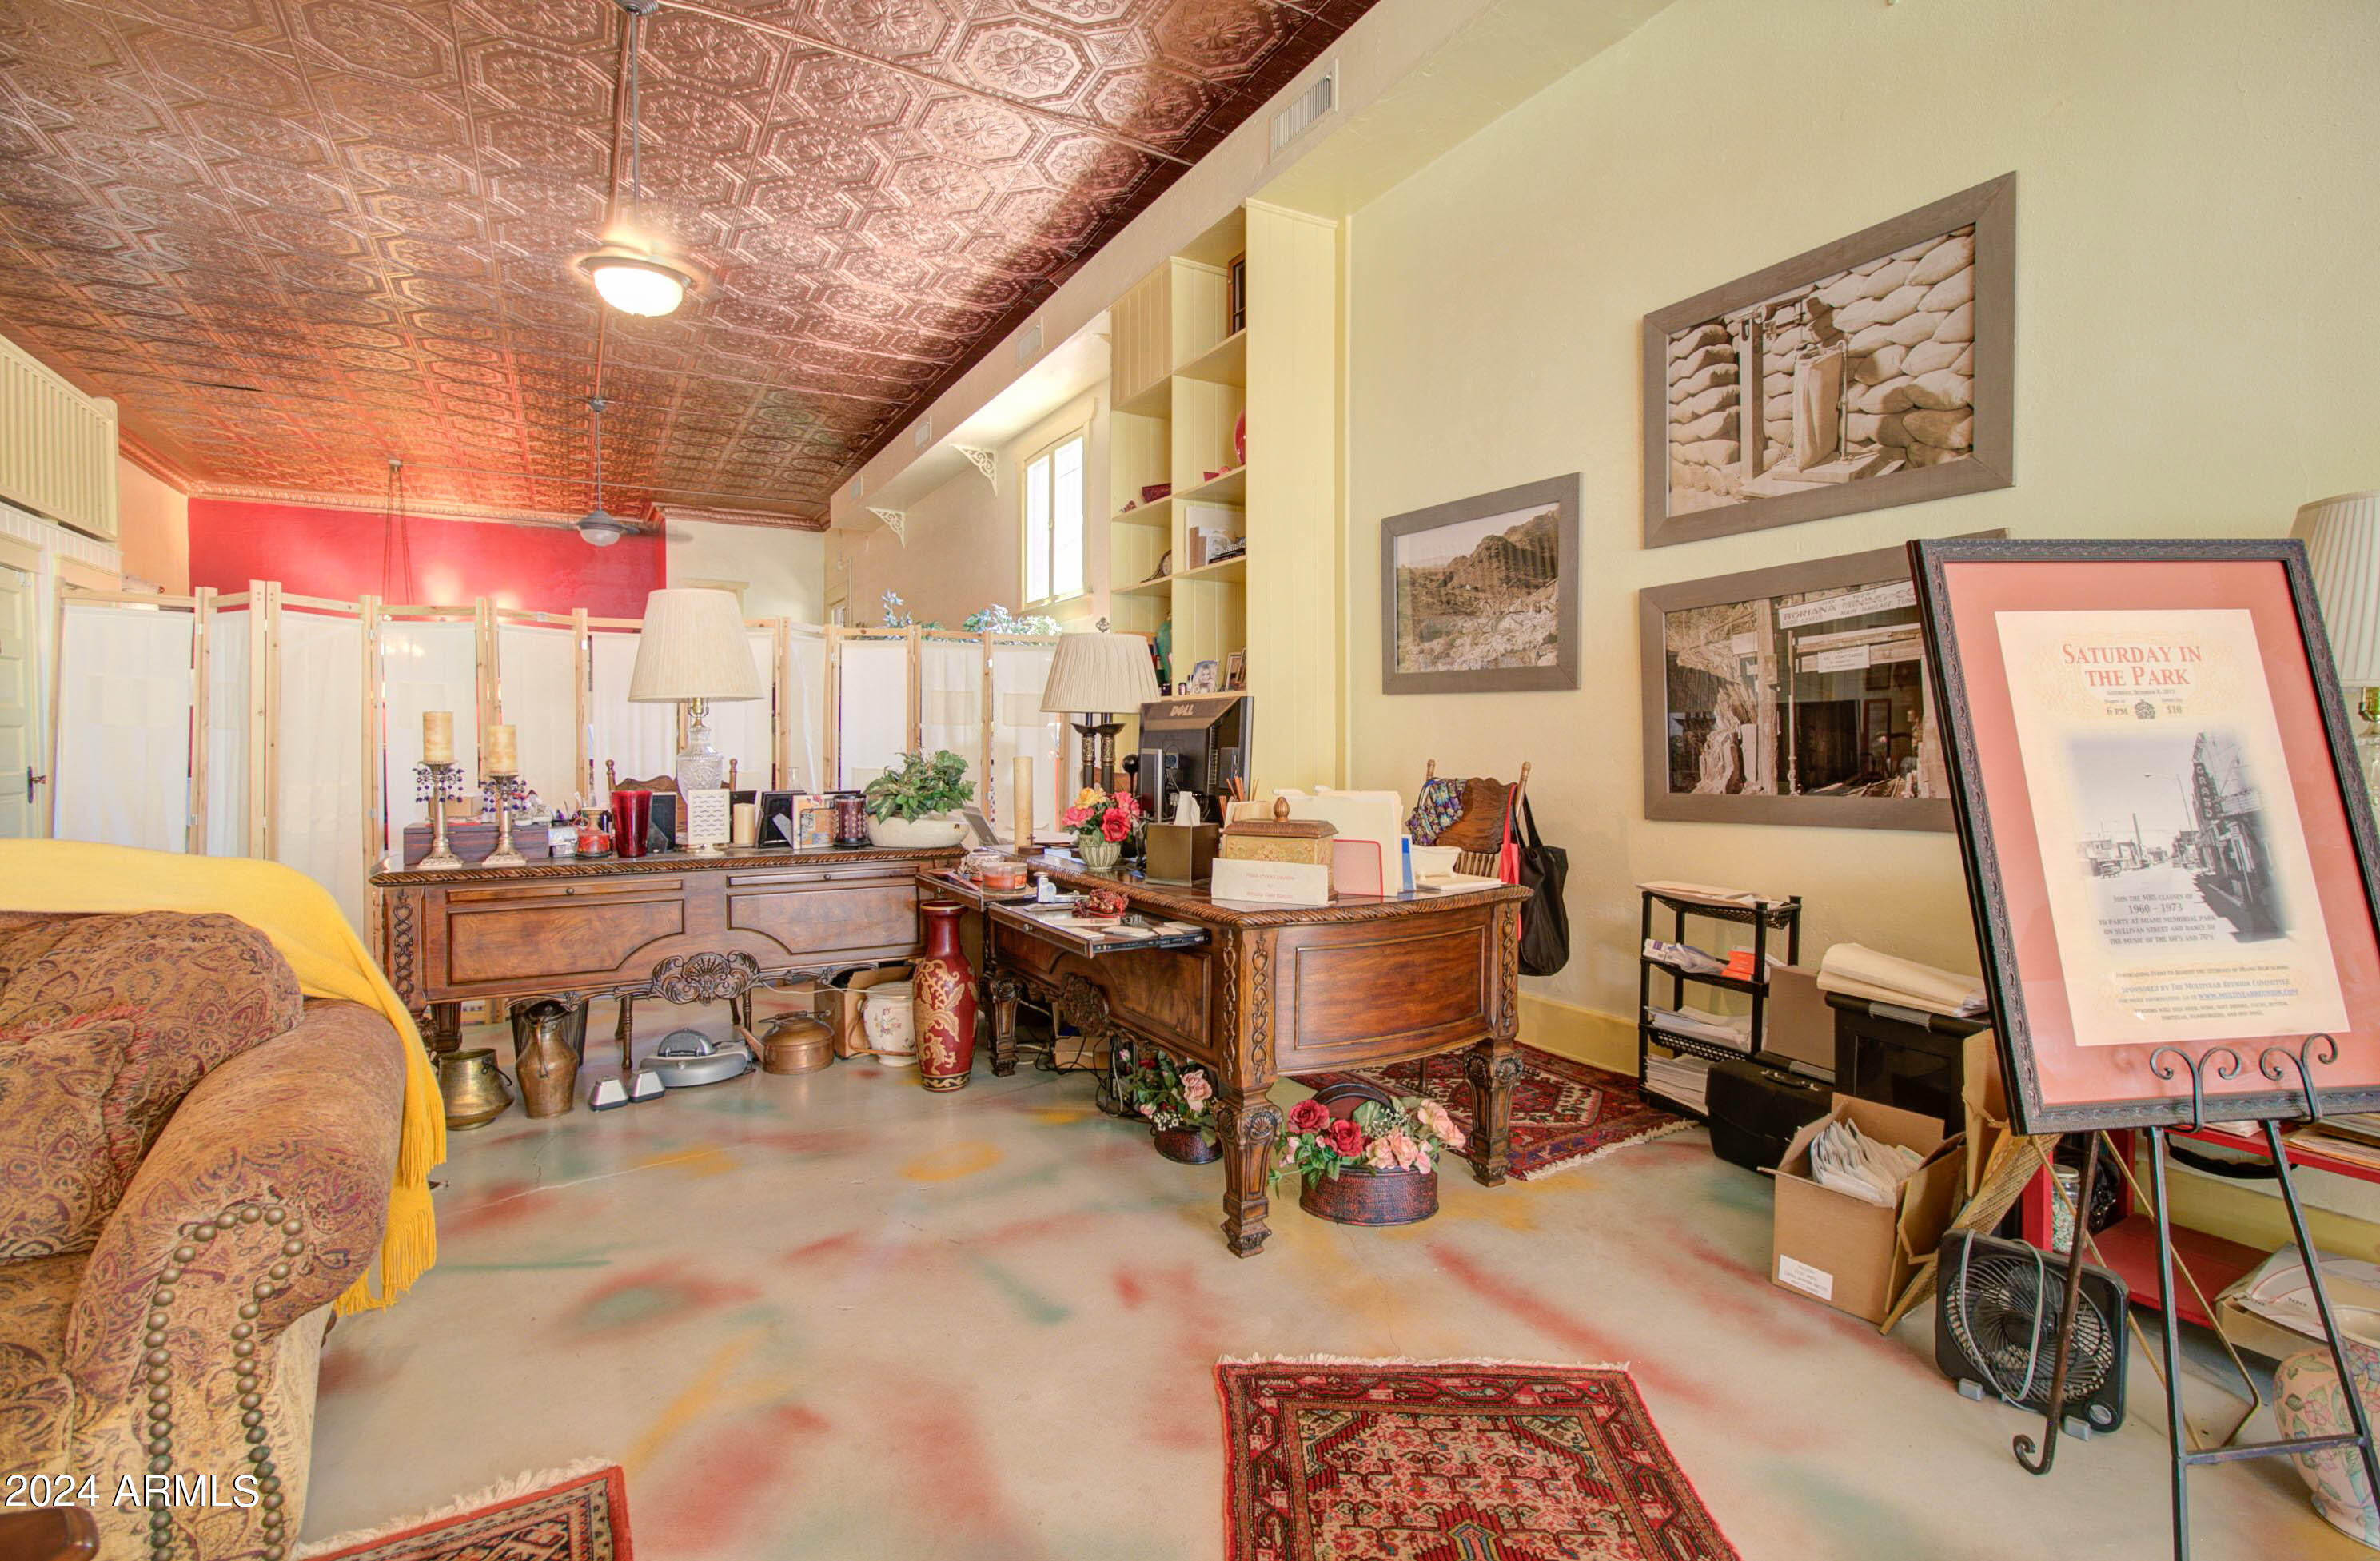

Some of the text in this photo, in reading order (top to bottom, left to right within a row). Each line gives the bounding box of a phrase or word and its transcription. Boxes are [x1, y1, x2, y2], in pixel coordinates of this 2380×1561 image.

[2062, 643, 2171, 664] SATURDAY
[2085, 666, 2191, 687] THE PARK
[1170, 703, 1194, 717] DELL
[2128, 903, 2183, 914] 1960 1973
